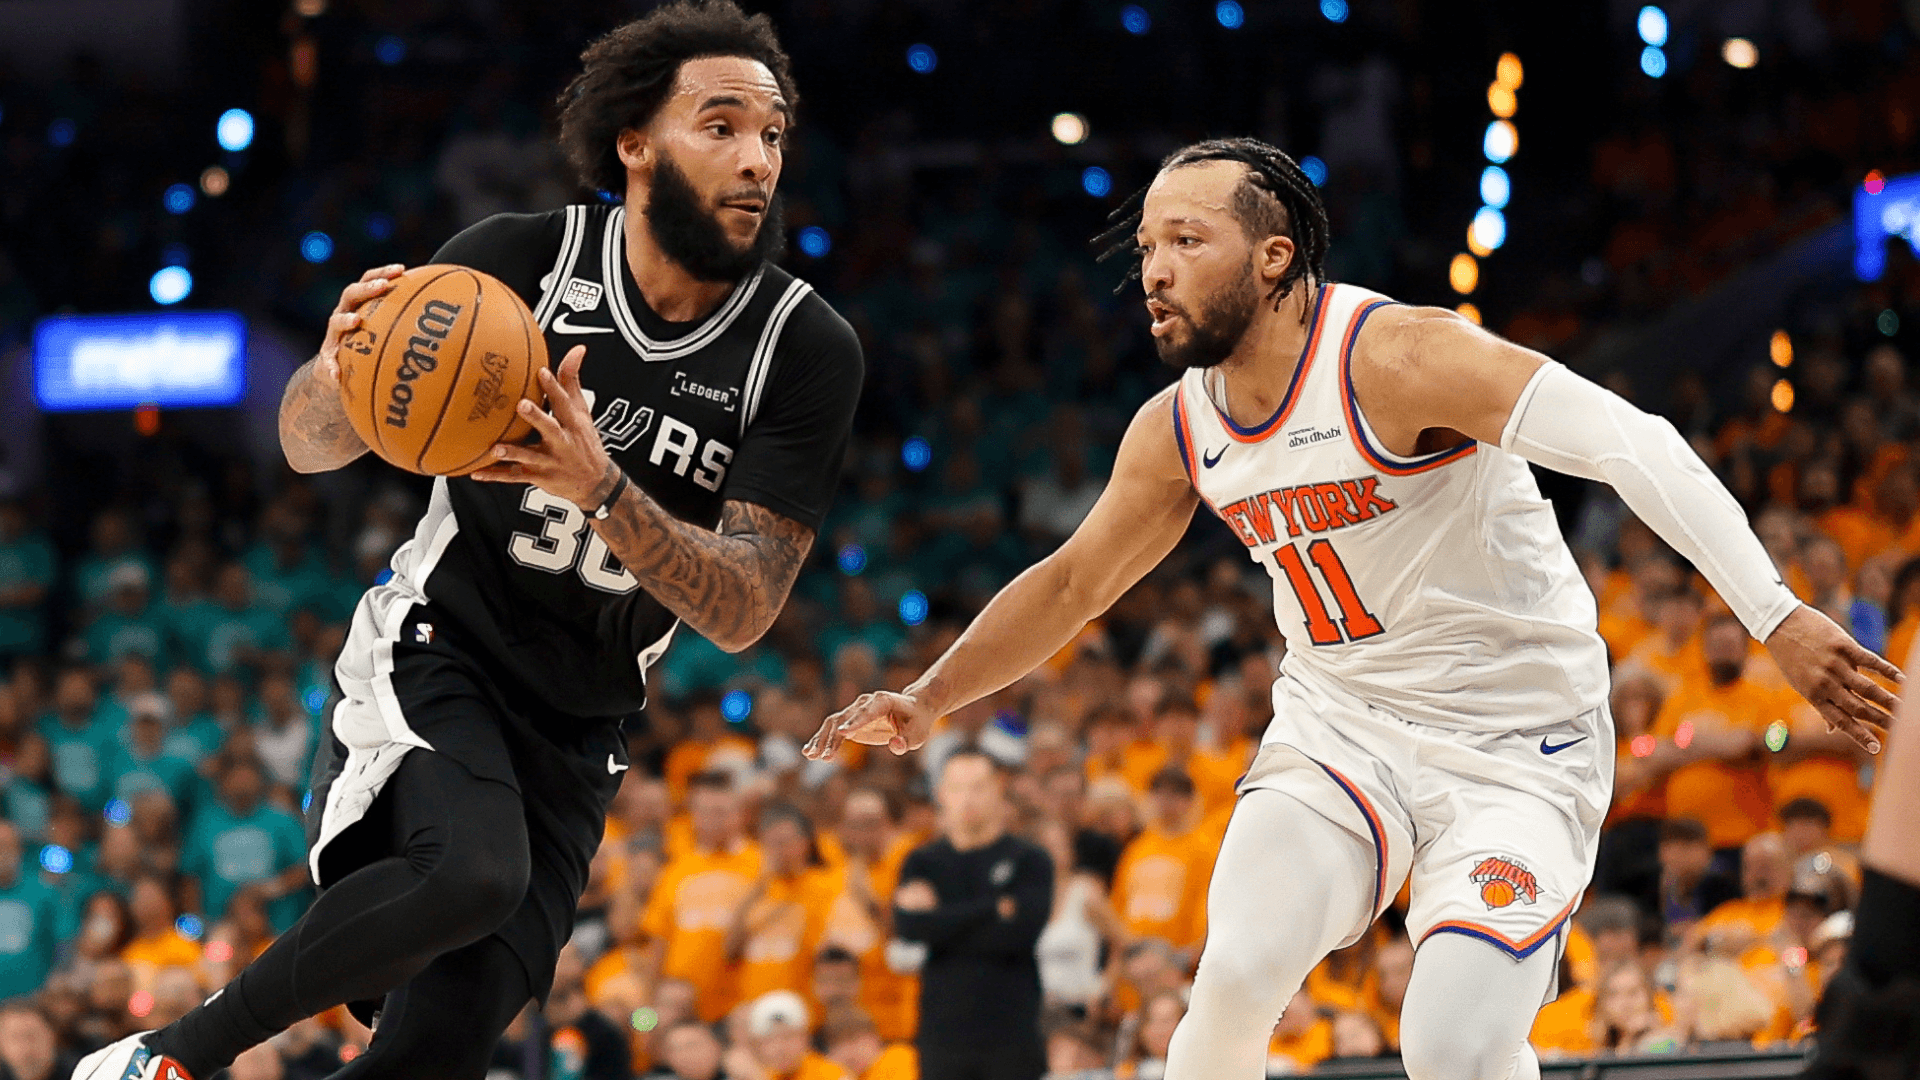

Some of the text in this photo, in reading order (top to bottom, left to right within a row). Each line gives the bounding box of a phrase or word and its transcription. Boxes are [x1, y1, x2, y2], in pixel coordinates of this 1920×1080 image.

[385, 299, 463, 429] Wilson
[680, 380, 729, 404] LEDGER
[581, 388, 734, 493] URS
[1288, 425, 1341, 448] abu dhabi
[508, 485, 640, 595] 30
[1271, 475, 1399, 539] YORK
[1272, 538, 1386, 646] 11
[1469, 857, 1536, 903] KNICKS
